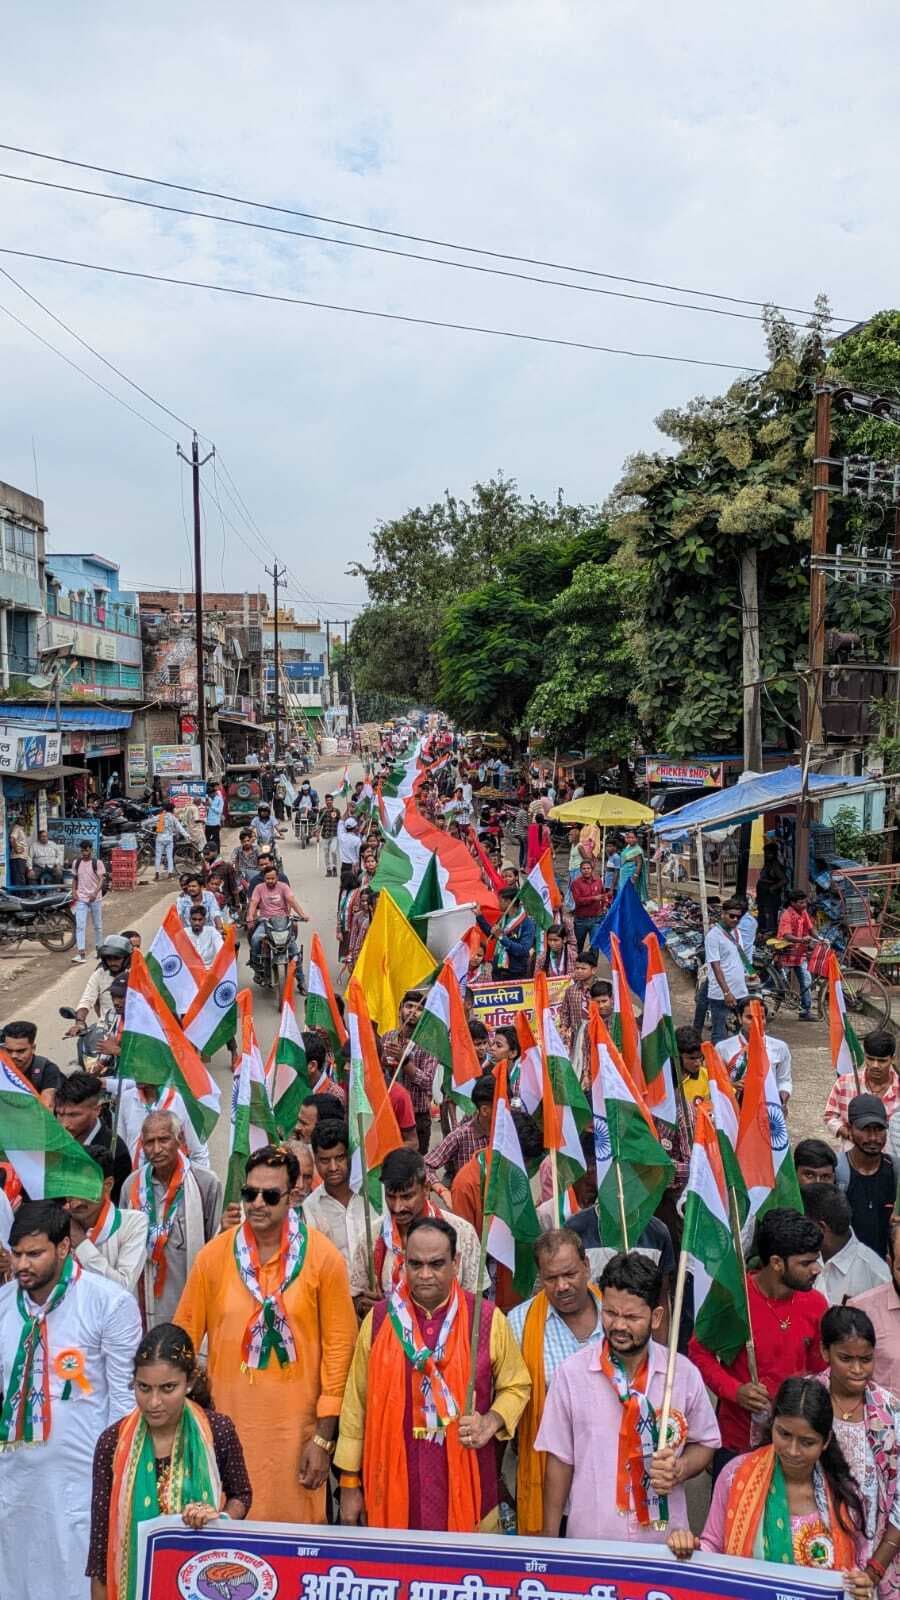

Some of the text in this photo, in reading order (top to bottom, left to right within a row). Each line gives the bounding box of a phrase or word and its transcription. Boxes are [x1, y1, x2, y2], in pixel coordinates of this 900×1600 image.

[656, 766, 709, 779] CHICKEN SHOP
[473, 989, 520, 1006] वासीय
